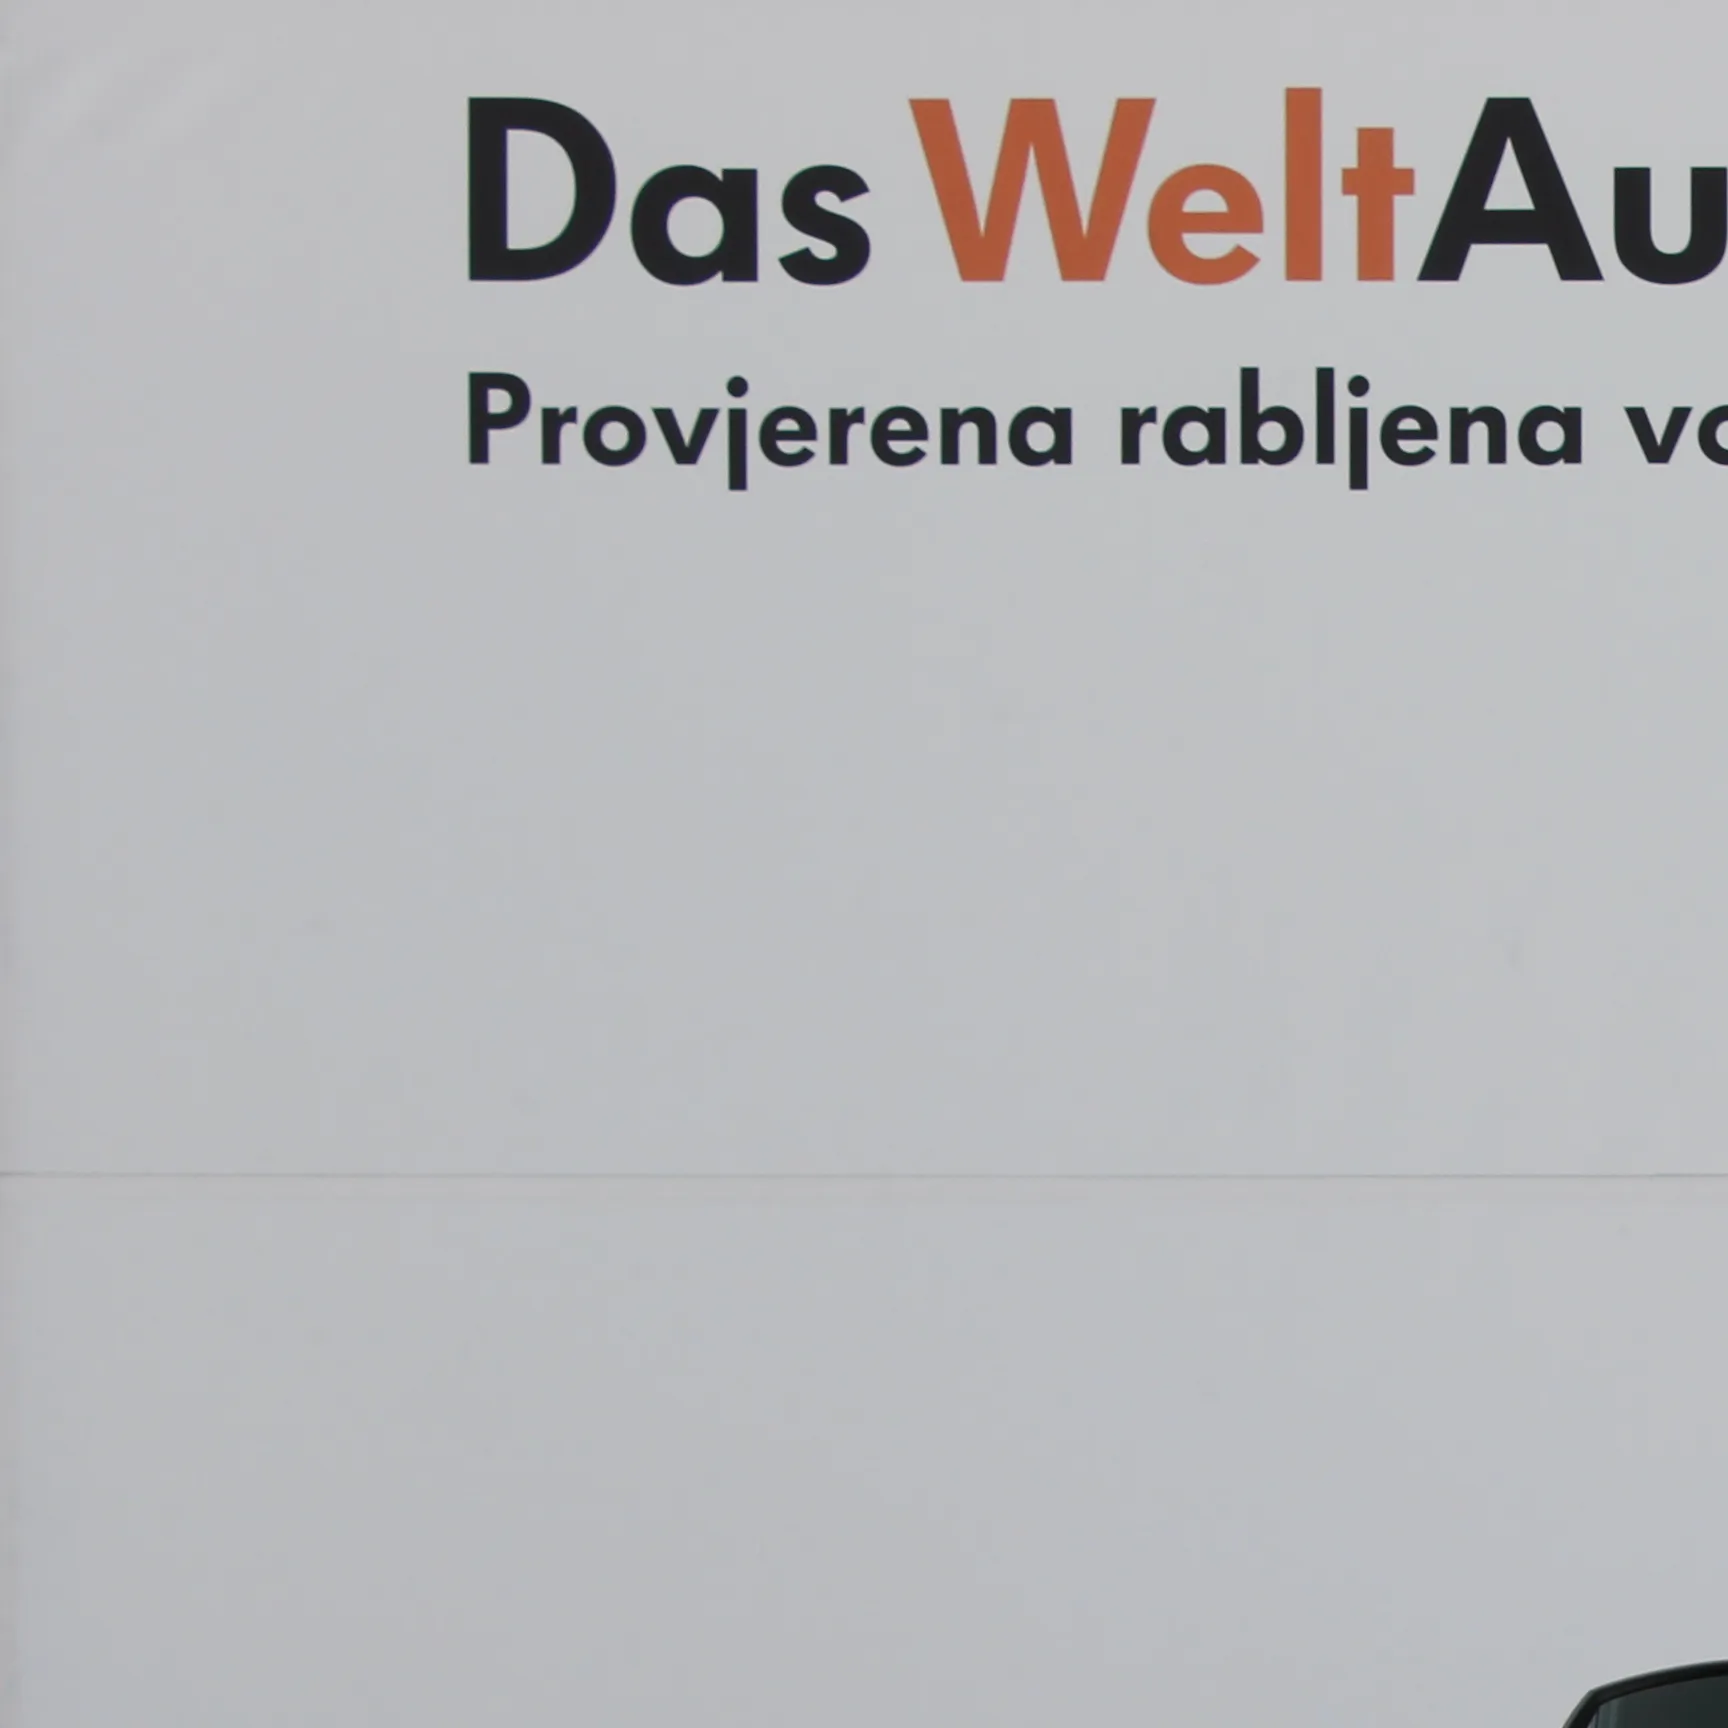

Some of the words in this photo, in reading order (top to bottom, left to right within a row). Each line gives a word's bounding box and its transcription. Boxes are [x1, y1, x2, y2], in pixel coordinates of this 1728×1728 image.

[467, 95, 872, 287] Das
[467, 370, 1073, 492] Provjerena
[1119, 365, 1583, 492] rabljena
